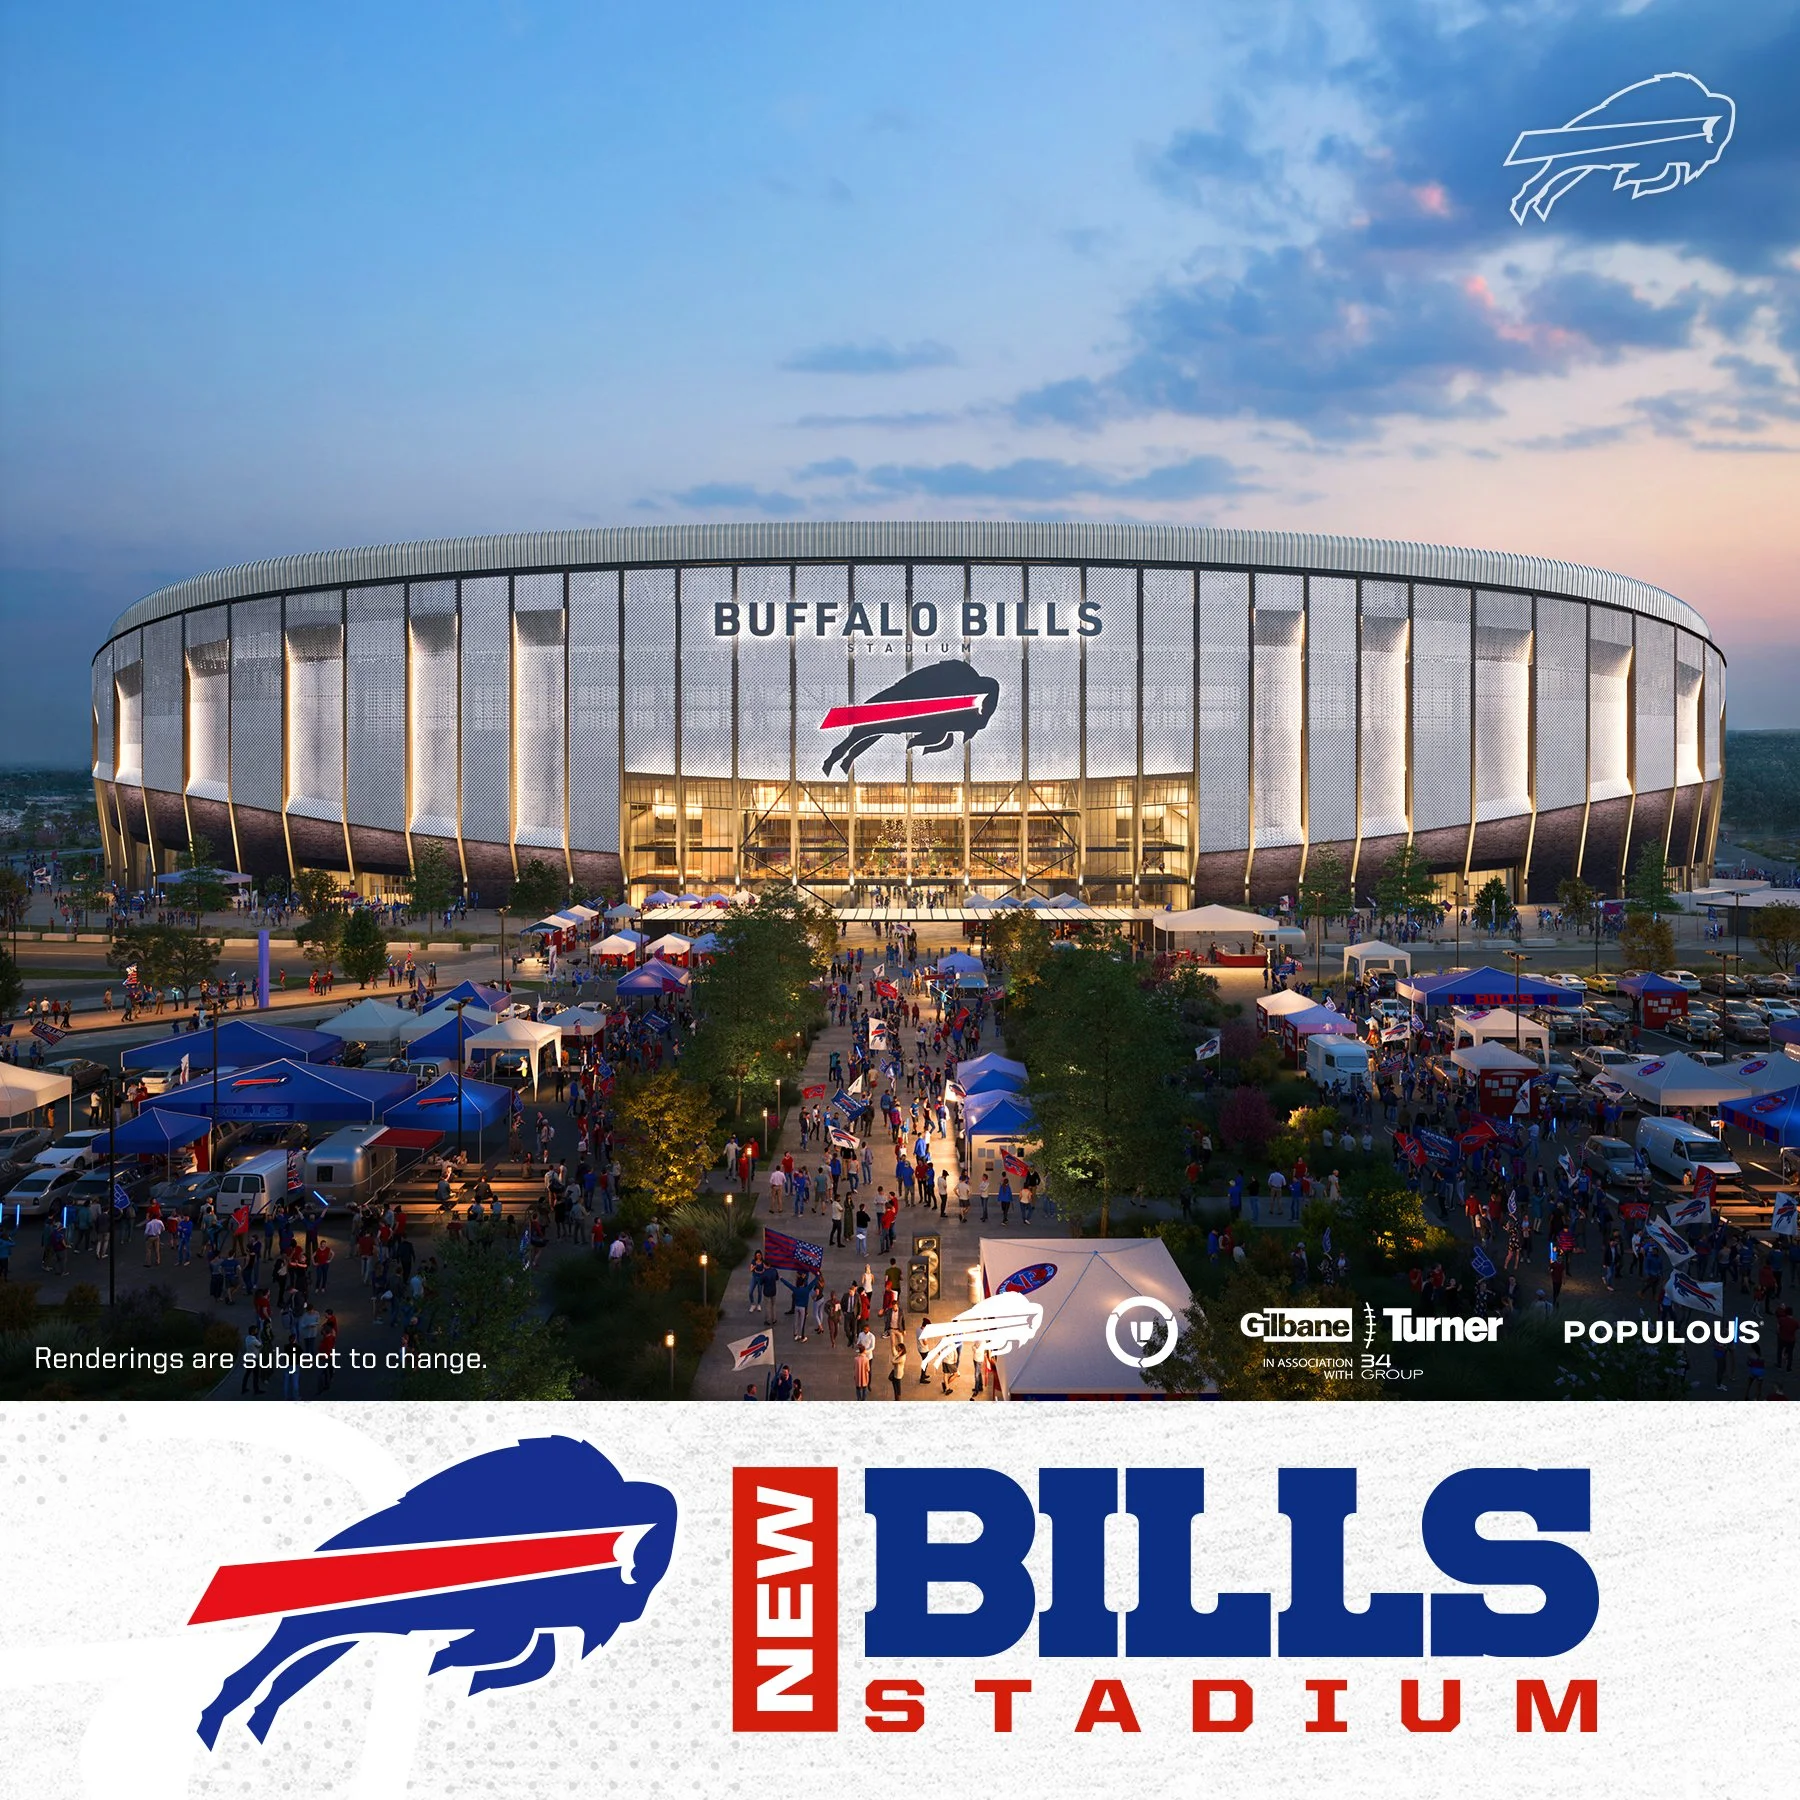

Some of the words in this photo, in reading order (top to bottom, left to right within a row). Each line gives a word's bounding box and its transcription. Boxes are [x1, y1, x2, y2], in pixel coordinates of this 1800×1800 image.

[714, 601, 937, 637] BUFFALO
[962, 601, 1102, 637] BILLS
[847, 643, 972, 654] STADIUM
[1474, 993, 1535, 1005] BILLS
[206, 1104, 289, 1118] BILLS
